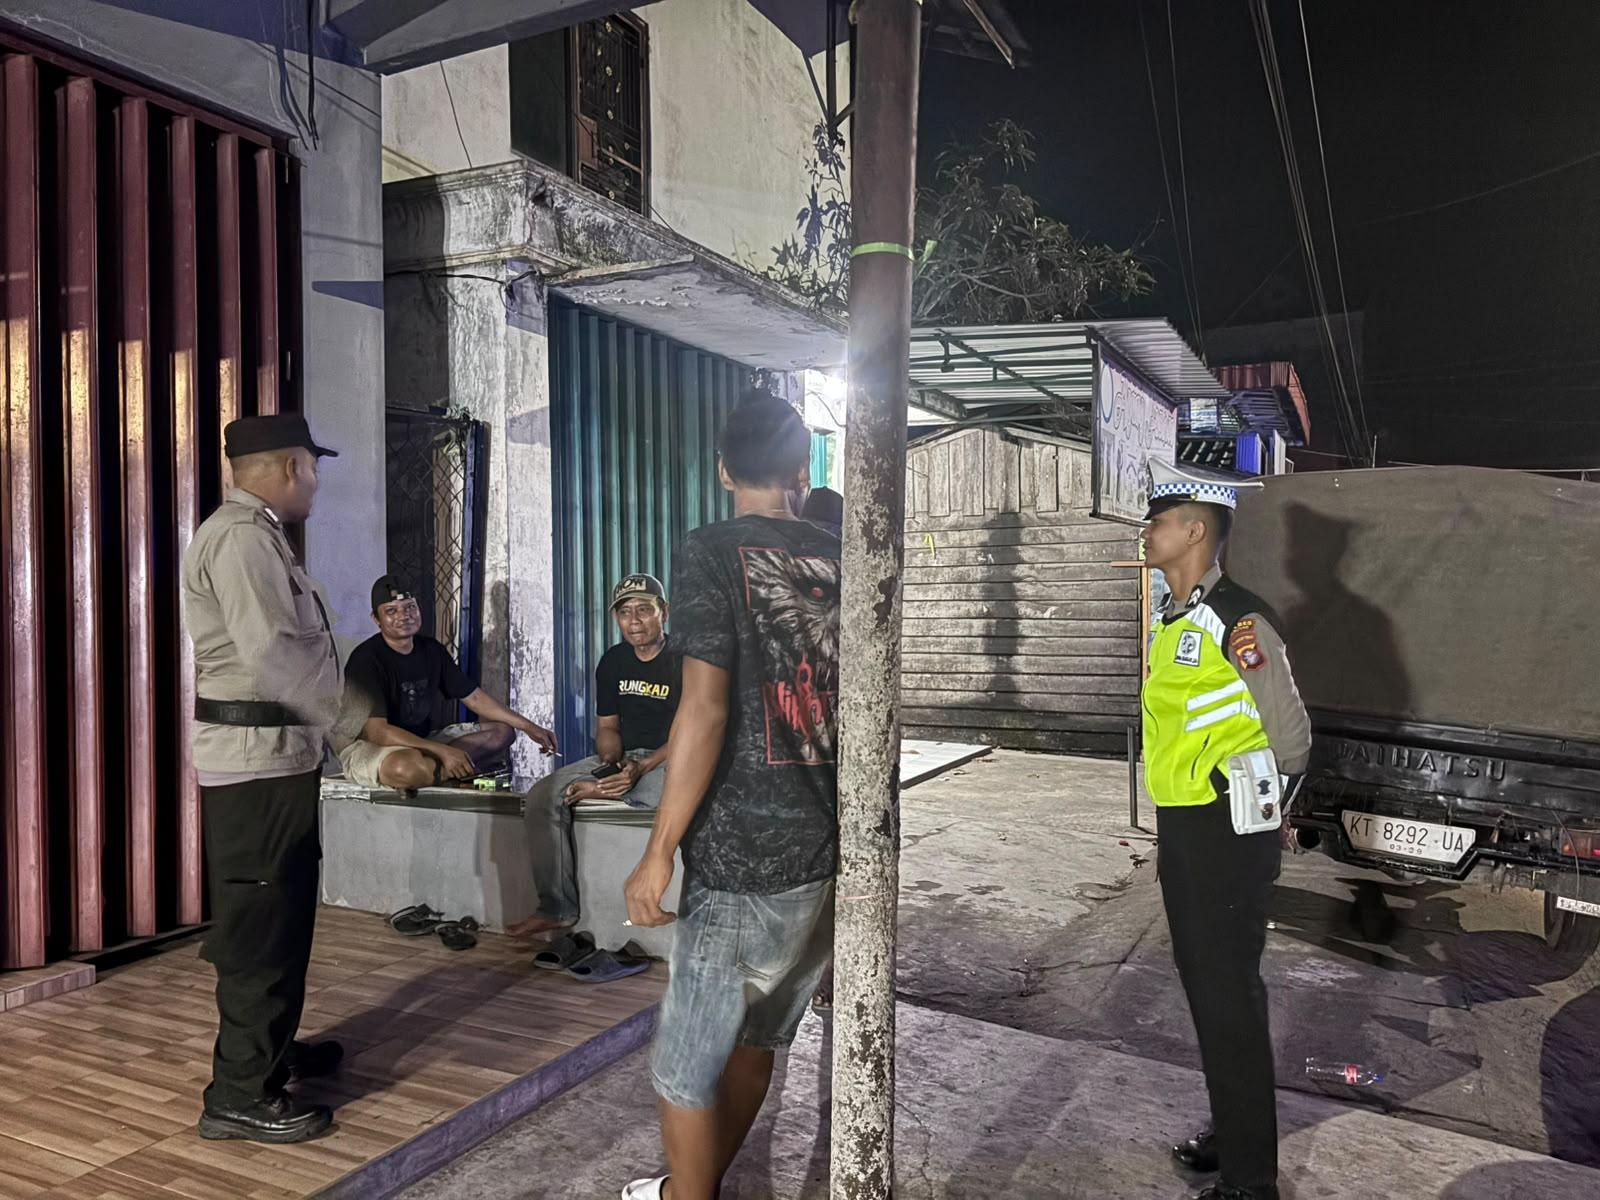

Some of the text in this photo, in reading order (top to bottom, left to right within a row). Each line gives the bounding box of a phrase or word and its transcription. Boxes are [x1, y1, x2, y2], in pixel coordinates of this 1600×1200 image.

[618, 679, 670, 697] RUNGKAD
[1349, 815, 1464, 853] KT 8292 UA
